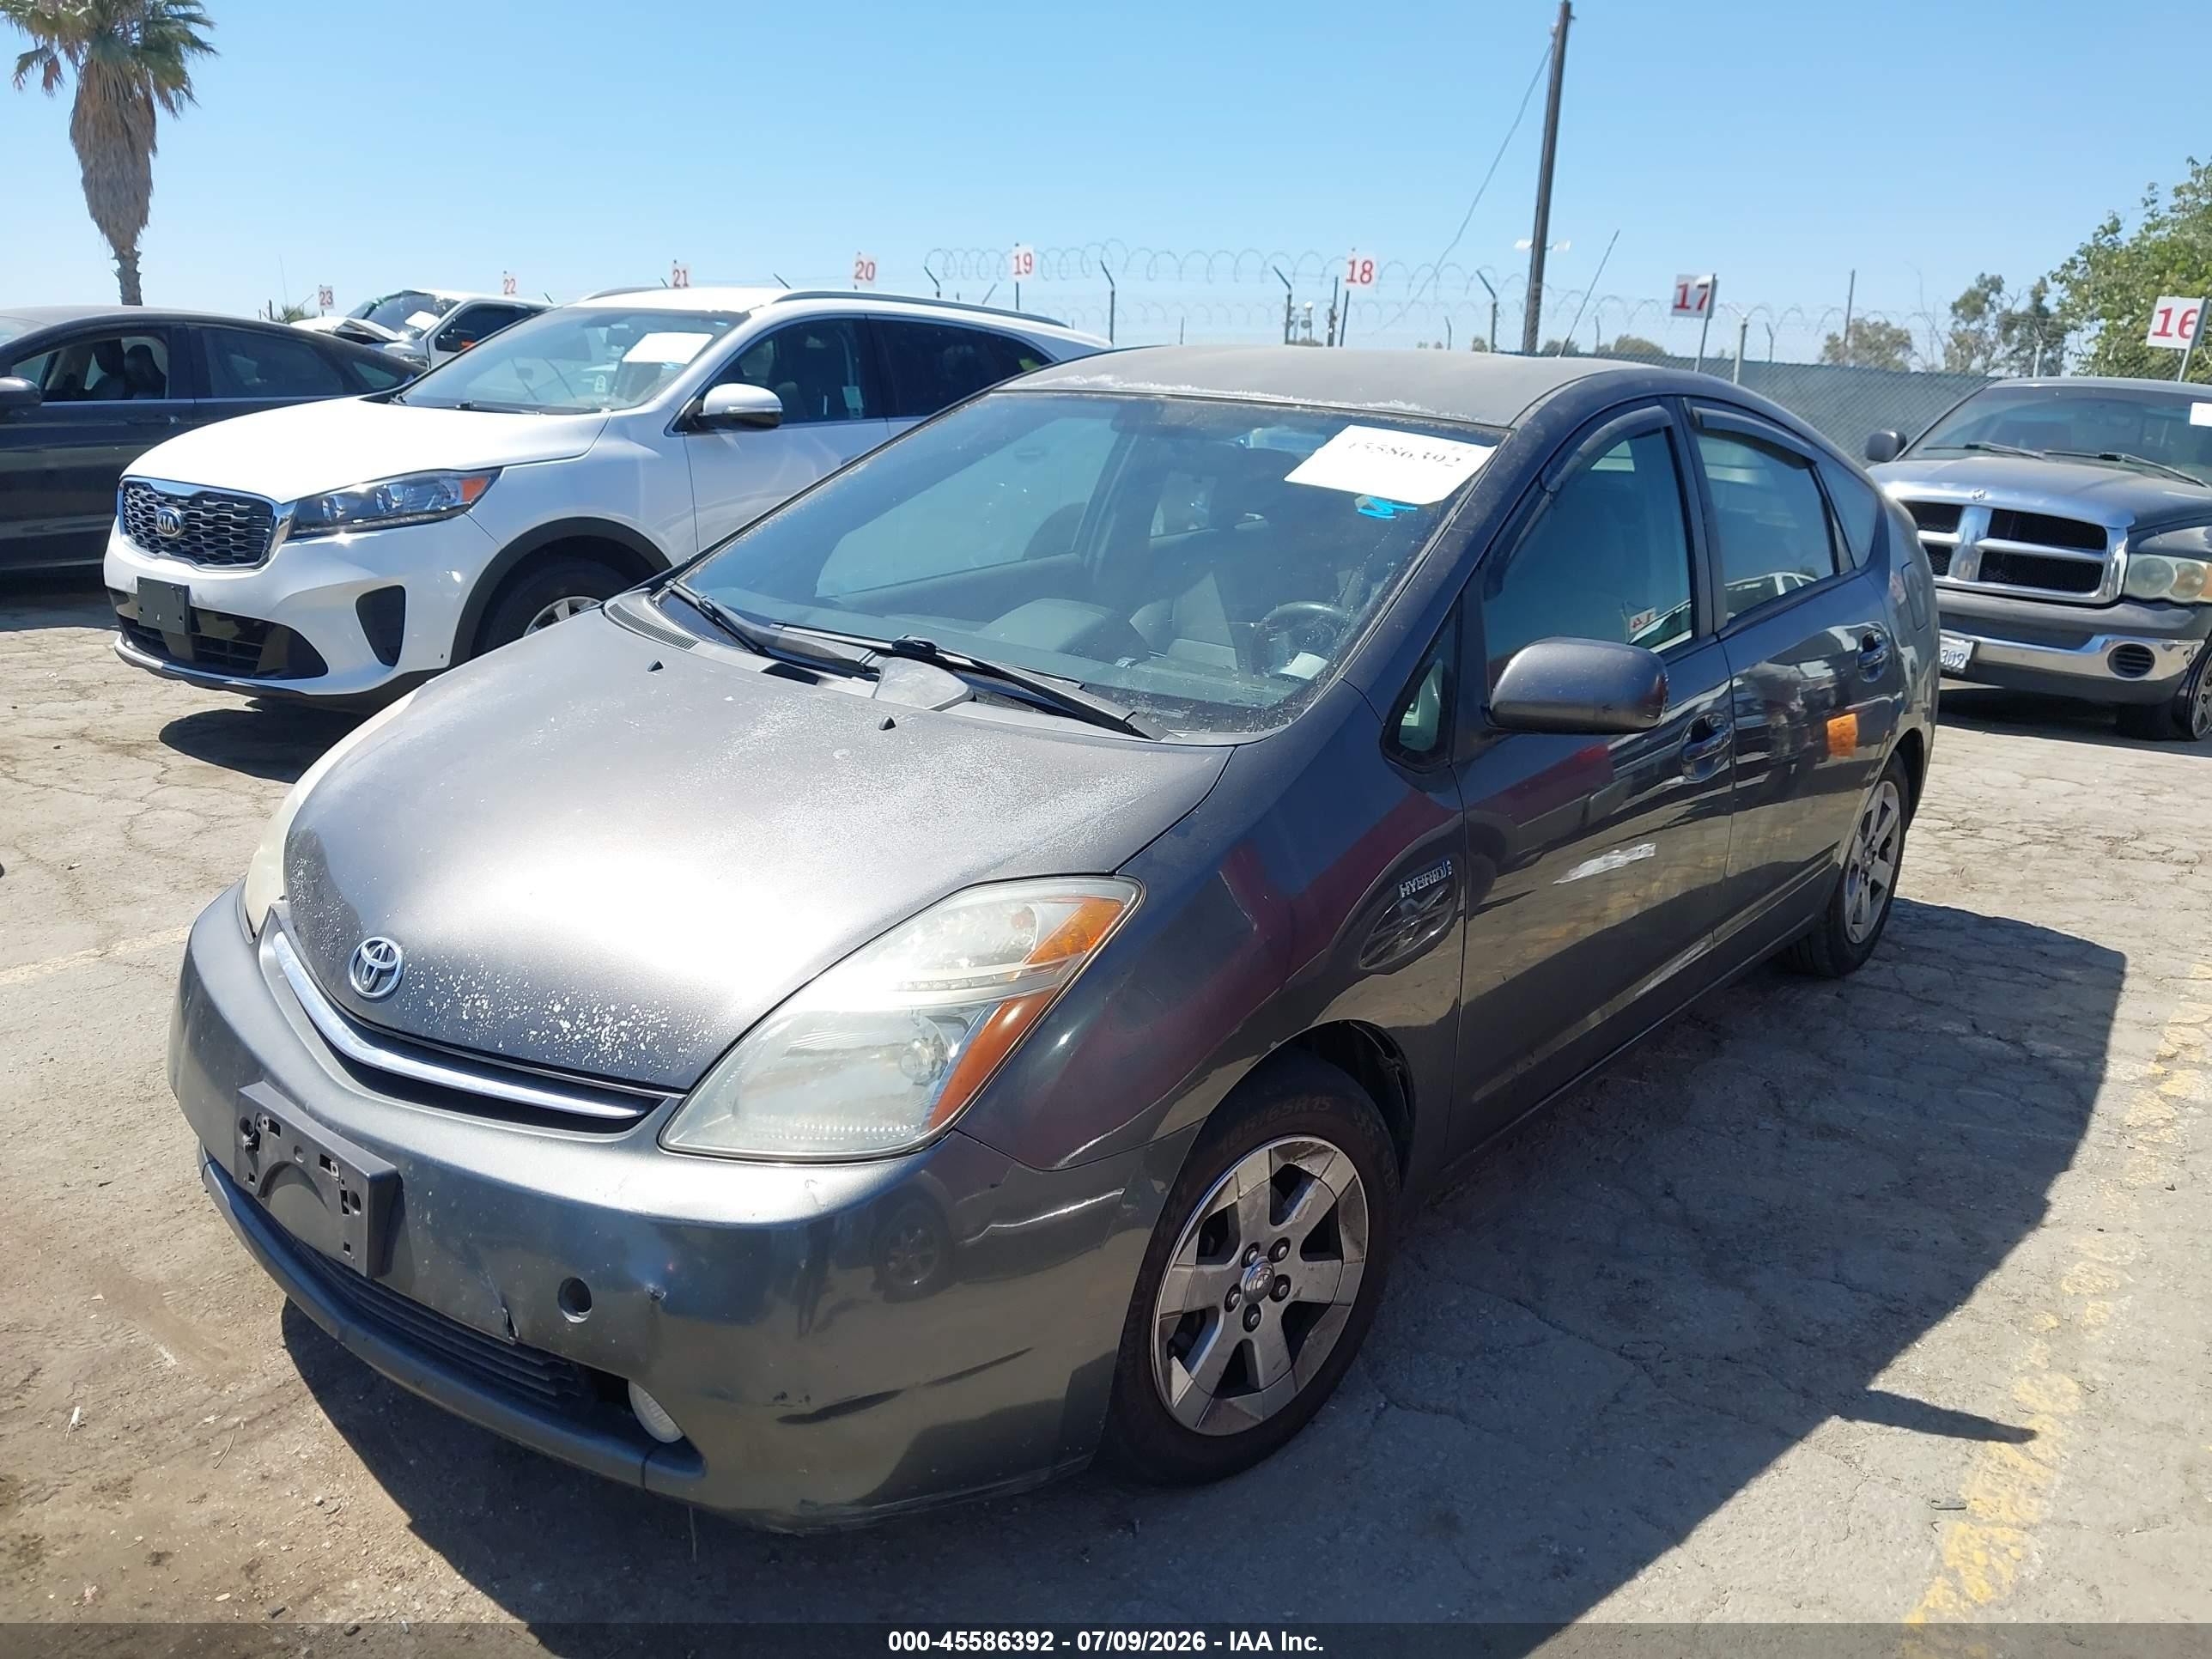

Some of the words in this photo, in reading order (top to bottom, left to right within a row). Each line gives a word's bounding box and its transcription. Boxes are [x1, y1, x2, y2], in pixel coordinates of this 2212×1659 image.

[854, 260, 875, 281] 20
[1013, 252, 1032, 275] 19
[1346, 260, 1373, 284] 18
[503, 278, 516, 295] 22
[673, 269, 690, 288] 21
[319, 290, 333, 306] 23
[1673, 283, 1709, 311] 17
[2152, 307, 2199, 339] 16
[1399, 864, 1447, 898] HYBRID
